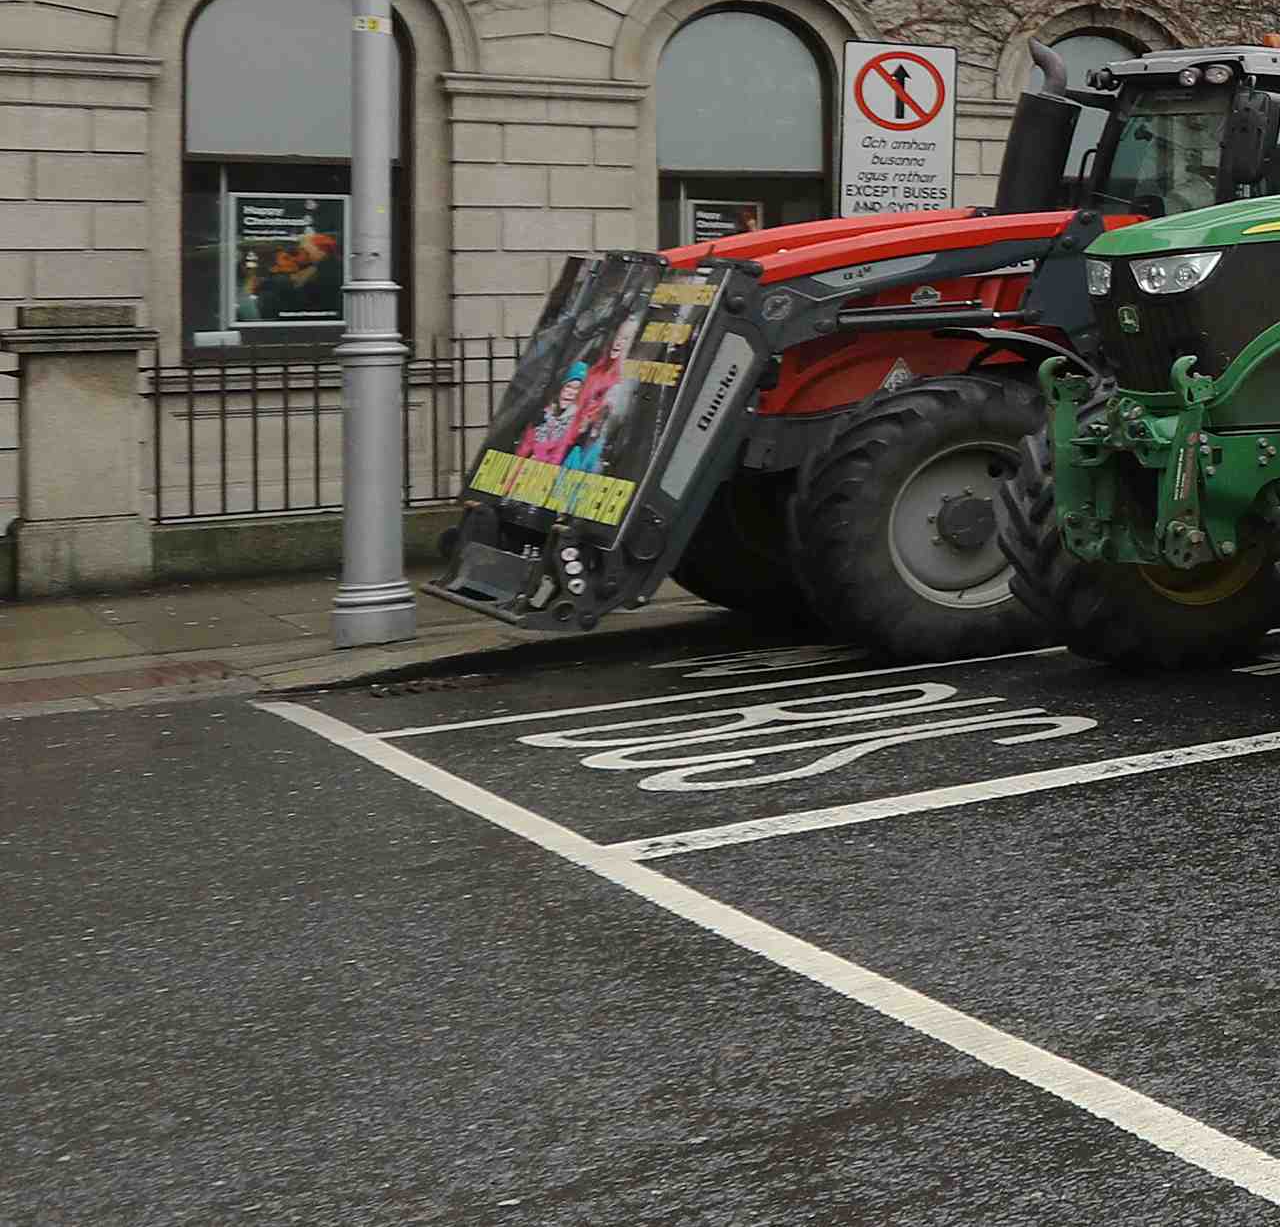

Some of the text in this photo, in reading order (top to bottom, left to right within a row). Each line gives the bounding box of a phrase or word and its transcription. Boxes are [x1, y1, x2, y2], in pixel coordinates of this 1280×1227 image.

[872, 152, 926, 166] busanna
[857, 171, 888, 183] agus
[846, 184, 947, 200] EXCEPT BUSES
